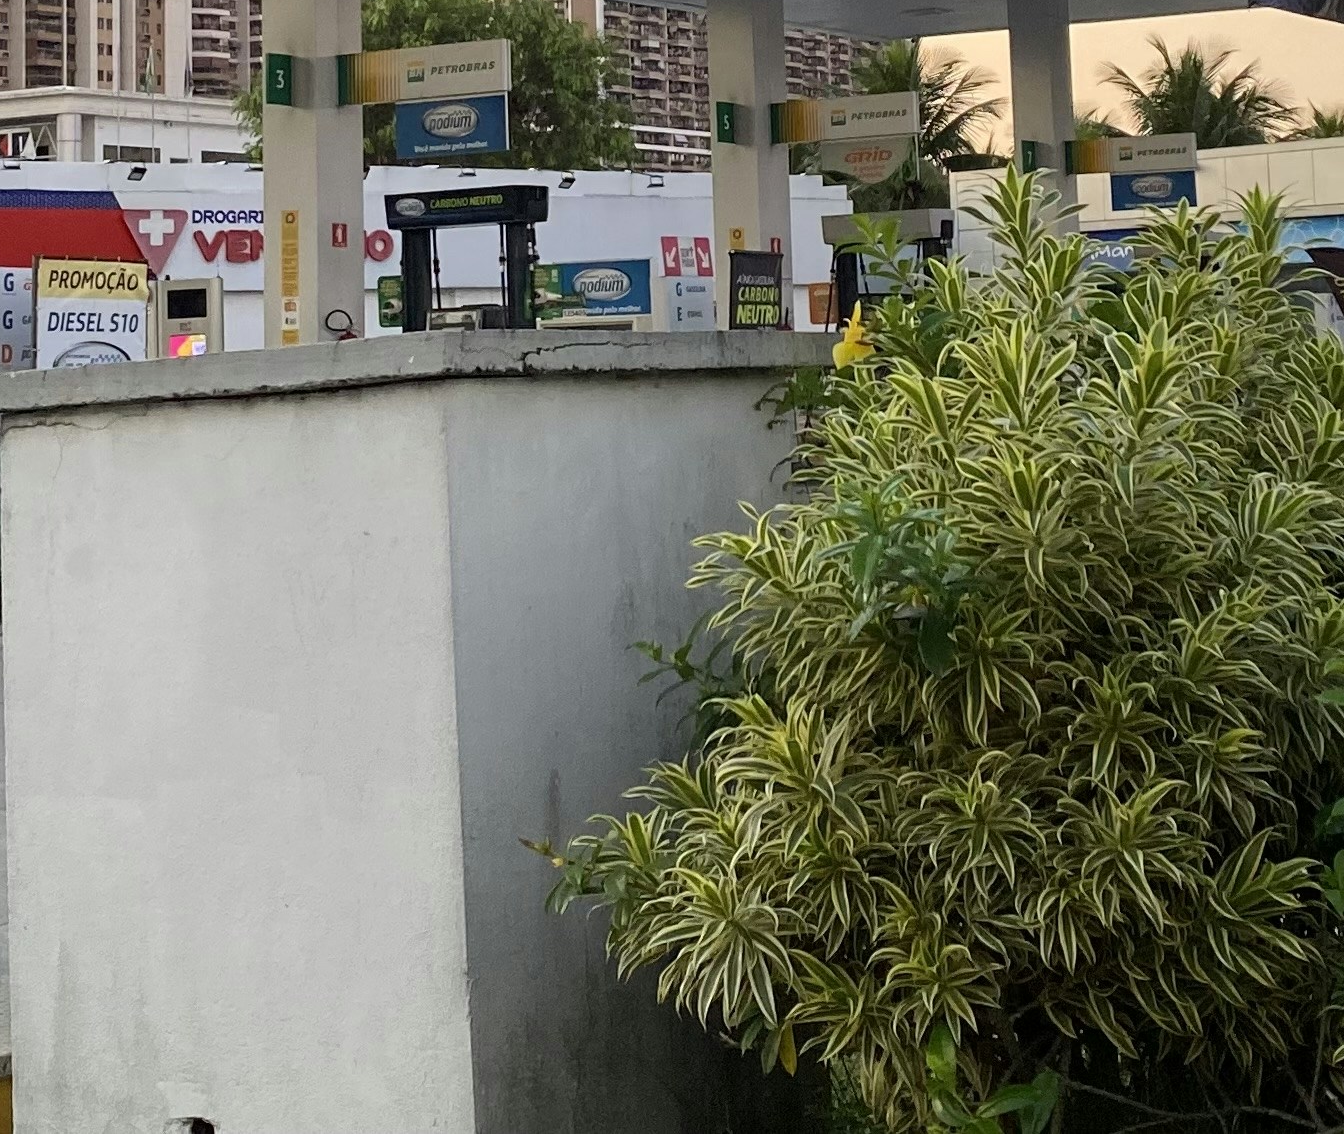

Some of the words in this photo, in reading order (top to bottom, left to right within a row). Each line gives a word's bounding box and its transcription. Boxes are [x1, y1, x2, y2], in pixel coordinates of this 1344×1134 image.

[430, 60, 496, 76] PETROBRAS
[275, 69, 285, 89] 3
[429, 112, 472, 131] podium
[724, 114, 730, 130] 5
[430, 196, 468, 210] CARBONO
[470, 194, 503, 206] NEUTRO
[192, 209, 264, 224] DROGARI
[3, 272, 15, 292] G
[48, 268, 139, 293] PROMOÇÃO
[579, 277, 624, 294] podium
[676, 282, 683, 296] G
[738, 286, 779, 302] CARBONO
[2, 309, 14, 329] G
[47, 312, 104, 333] DIESEL
[109, 313, 139, 333] S10
[736, 304, 780, 325] NEUTRO
[1, 344, 13, 363] D
